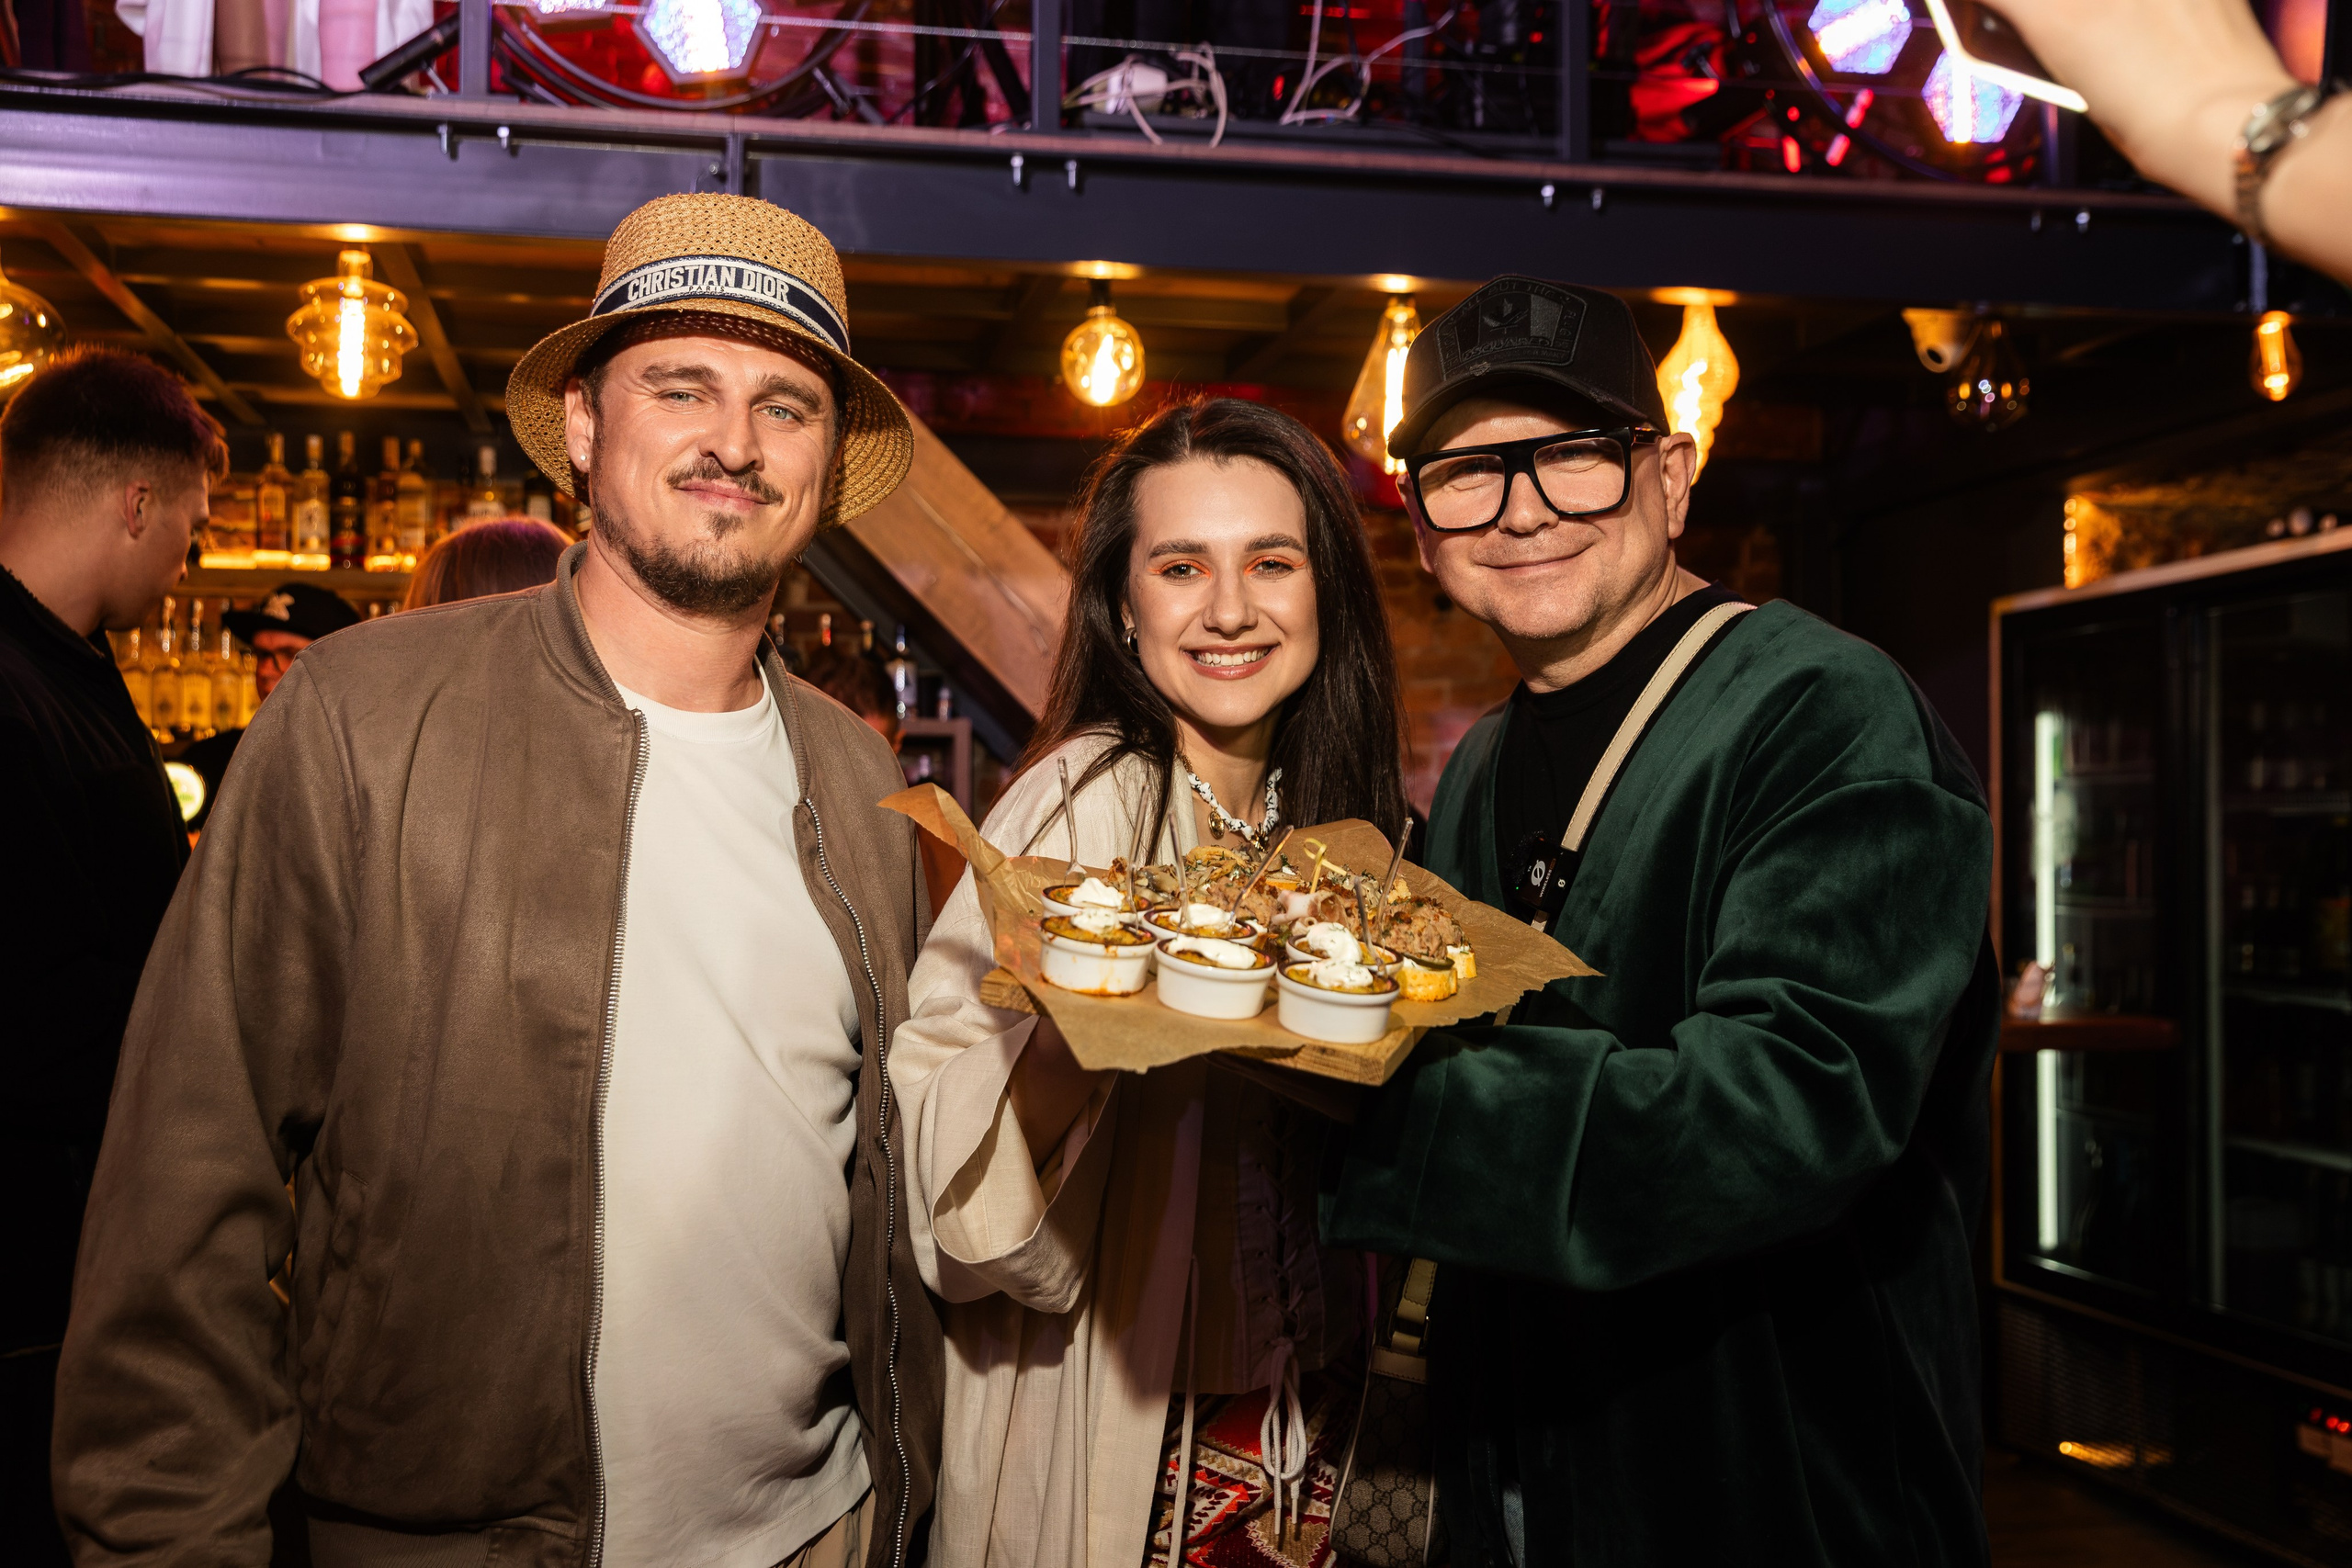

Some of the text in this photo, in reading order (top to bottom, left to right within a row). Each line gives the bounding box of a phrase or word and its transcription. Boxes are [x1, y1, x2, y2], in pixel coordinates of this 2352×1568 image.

[628, 265, 789, 304] CHRISTIAN DIOR
[1539, 869, 1553, 897] WIRELESS
